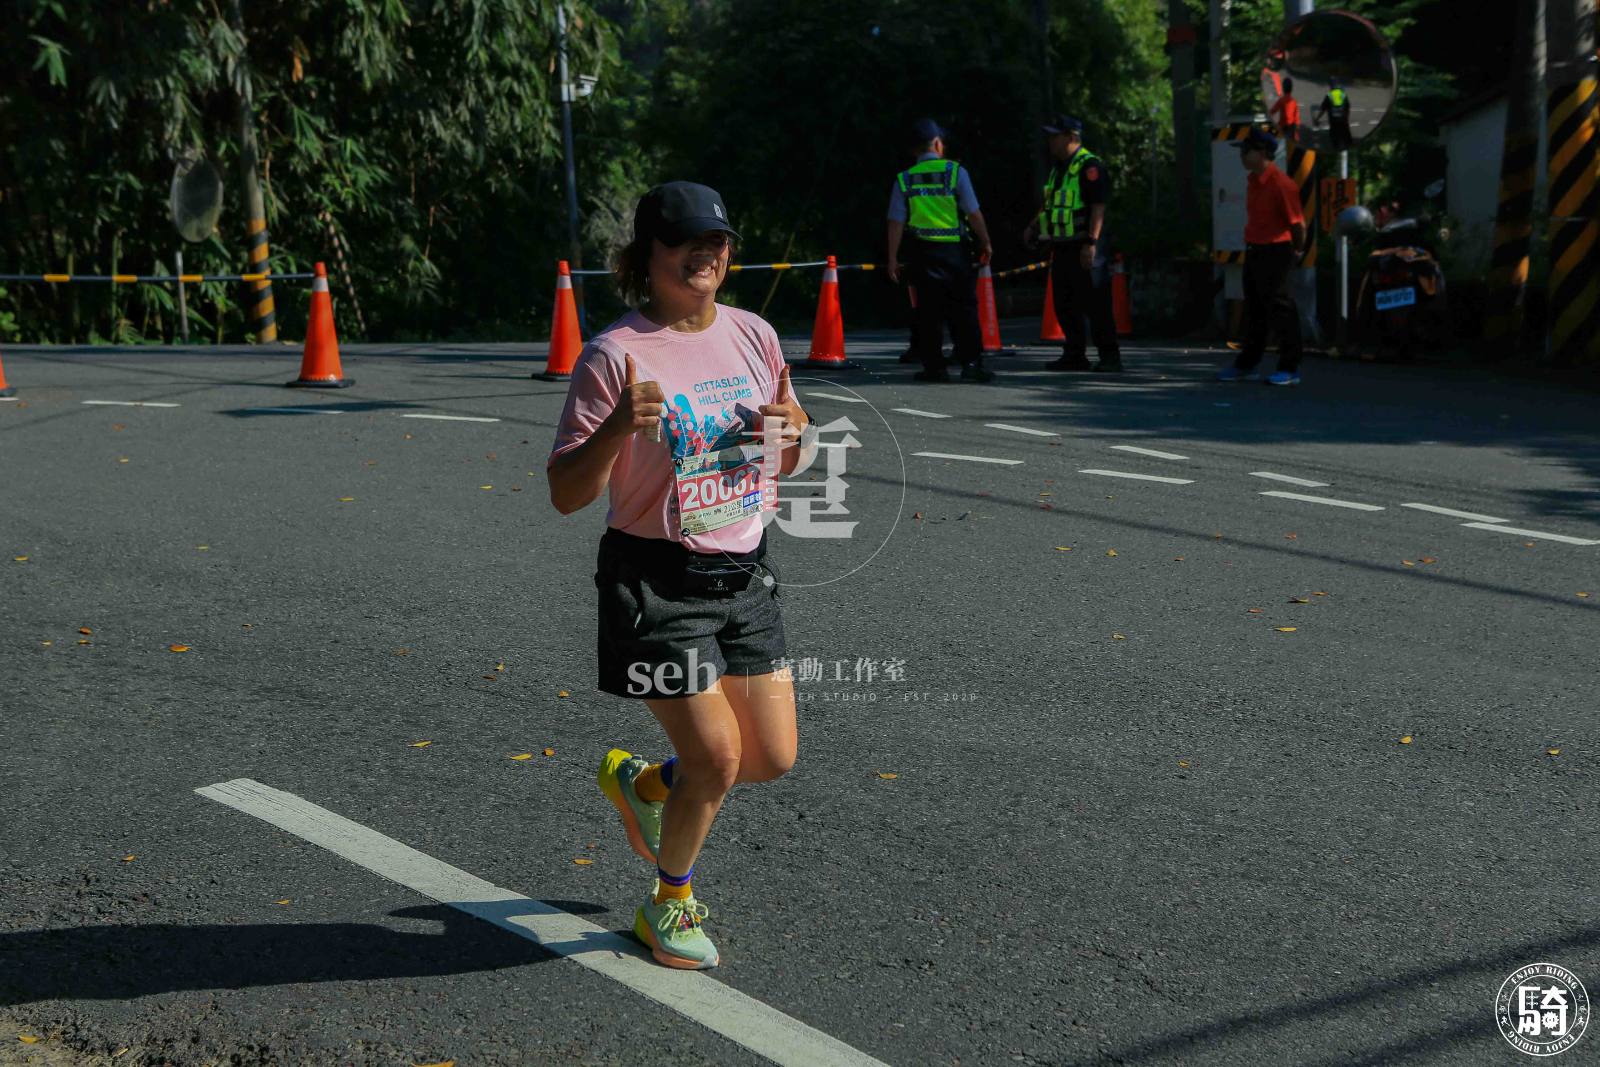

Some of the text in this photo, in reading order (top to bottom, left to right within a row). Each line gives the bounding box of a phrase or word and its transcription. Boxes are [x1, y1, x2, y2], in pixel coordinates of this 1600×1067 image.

[693, 375, 748, 393] CITTASLOW
[698, 388, 753, 406] HILL CLIMB
[681, 465, 761, 511] 20067
